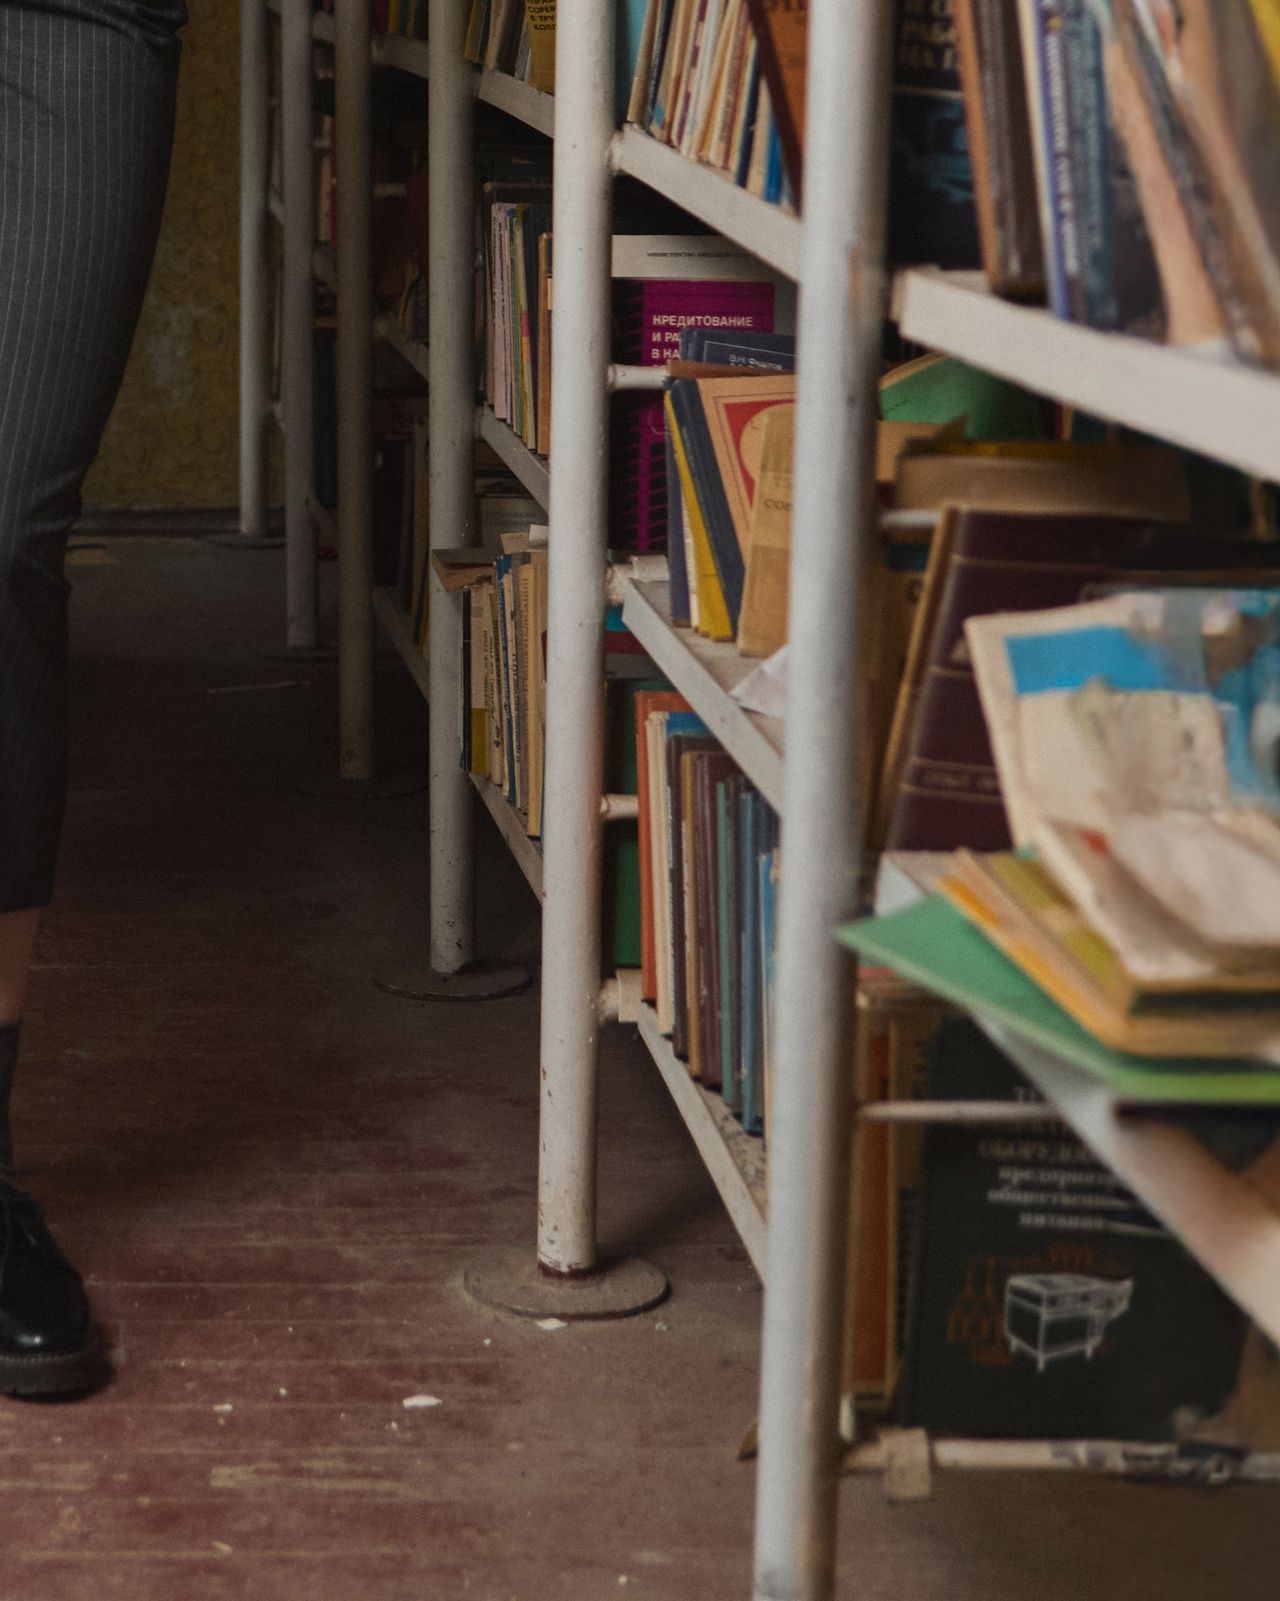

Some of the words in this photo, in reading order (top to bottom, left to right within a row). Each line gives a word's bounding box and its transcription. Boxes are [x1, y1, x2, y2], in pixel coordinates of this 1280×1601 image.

[652, 315, 754, 328] КРЕДИТОВАНИЕ
[651, 332, 661, 342] И
[651, 349, 660, 359] В
